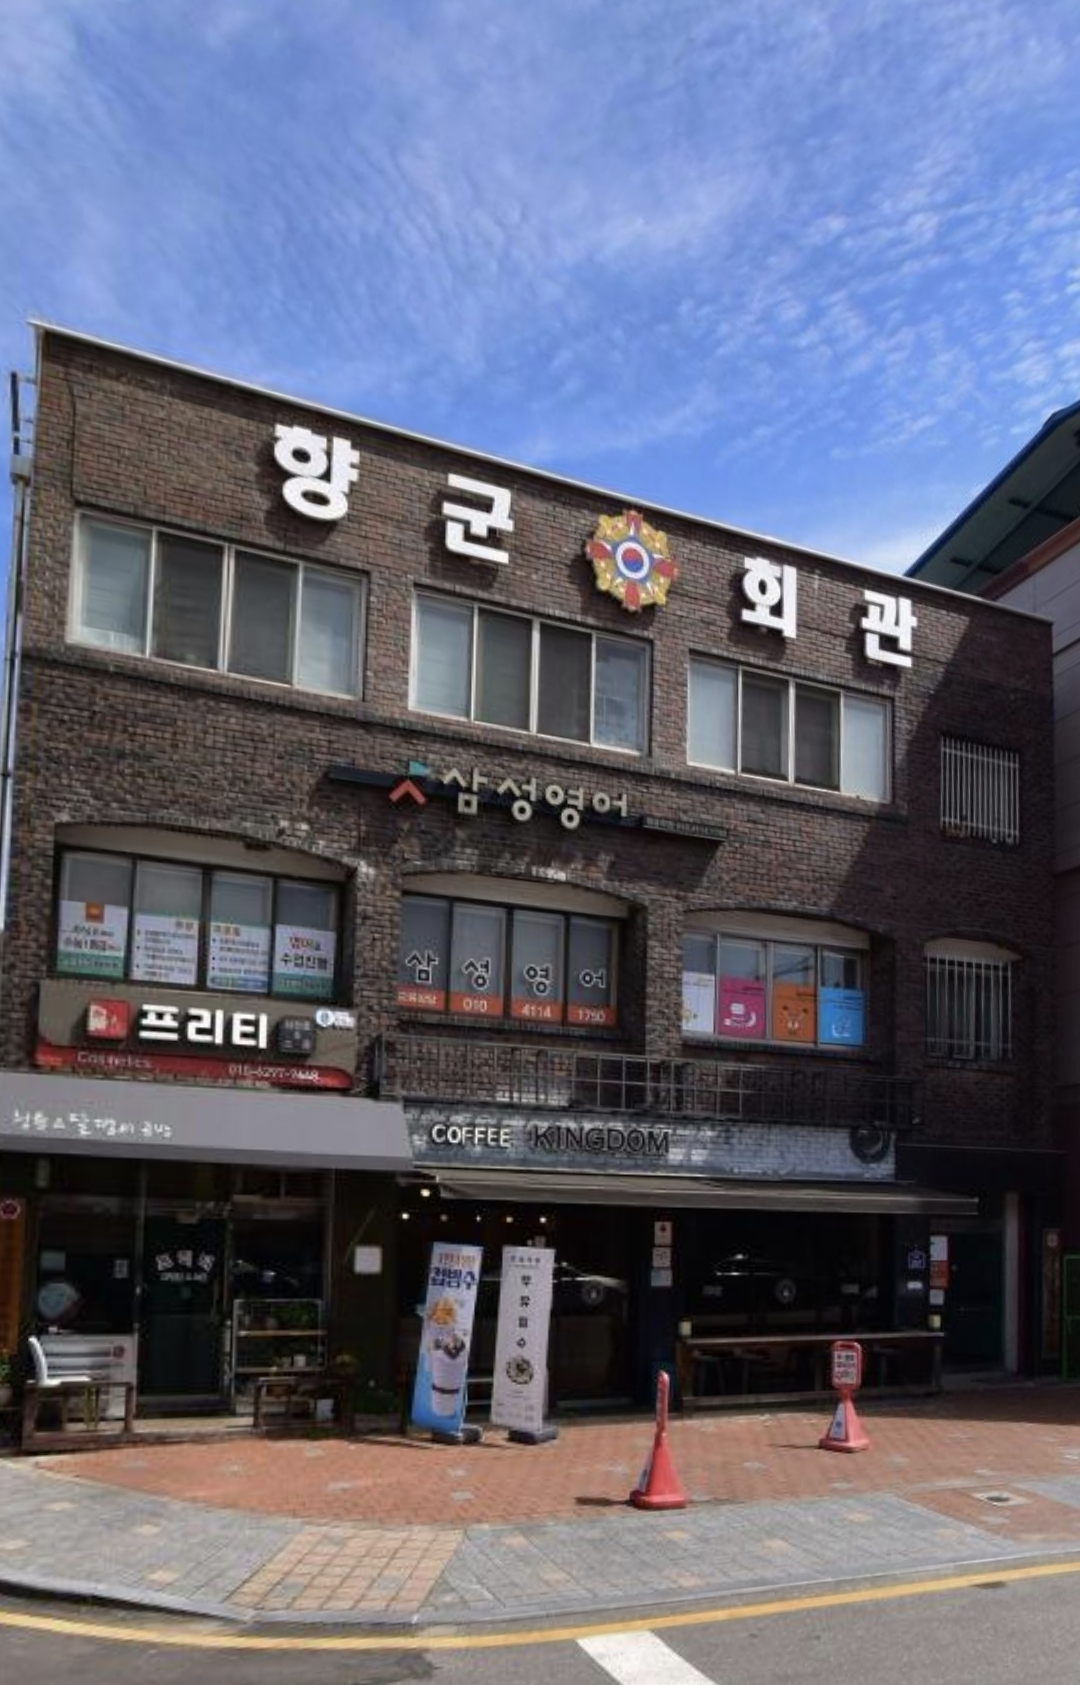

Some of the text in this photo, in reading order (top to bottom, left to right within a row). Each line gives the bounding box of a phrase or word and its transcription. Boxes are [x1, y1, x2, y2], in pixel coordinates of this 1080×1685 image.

[443, 767, 629, 830] 삼성영어
[463, 997, 488, 1013] 010
[139, 1003, 269, 1049] 프리티
[431, 1123, 671, 1155] COFFEE KINGDOM
